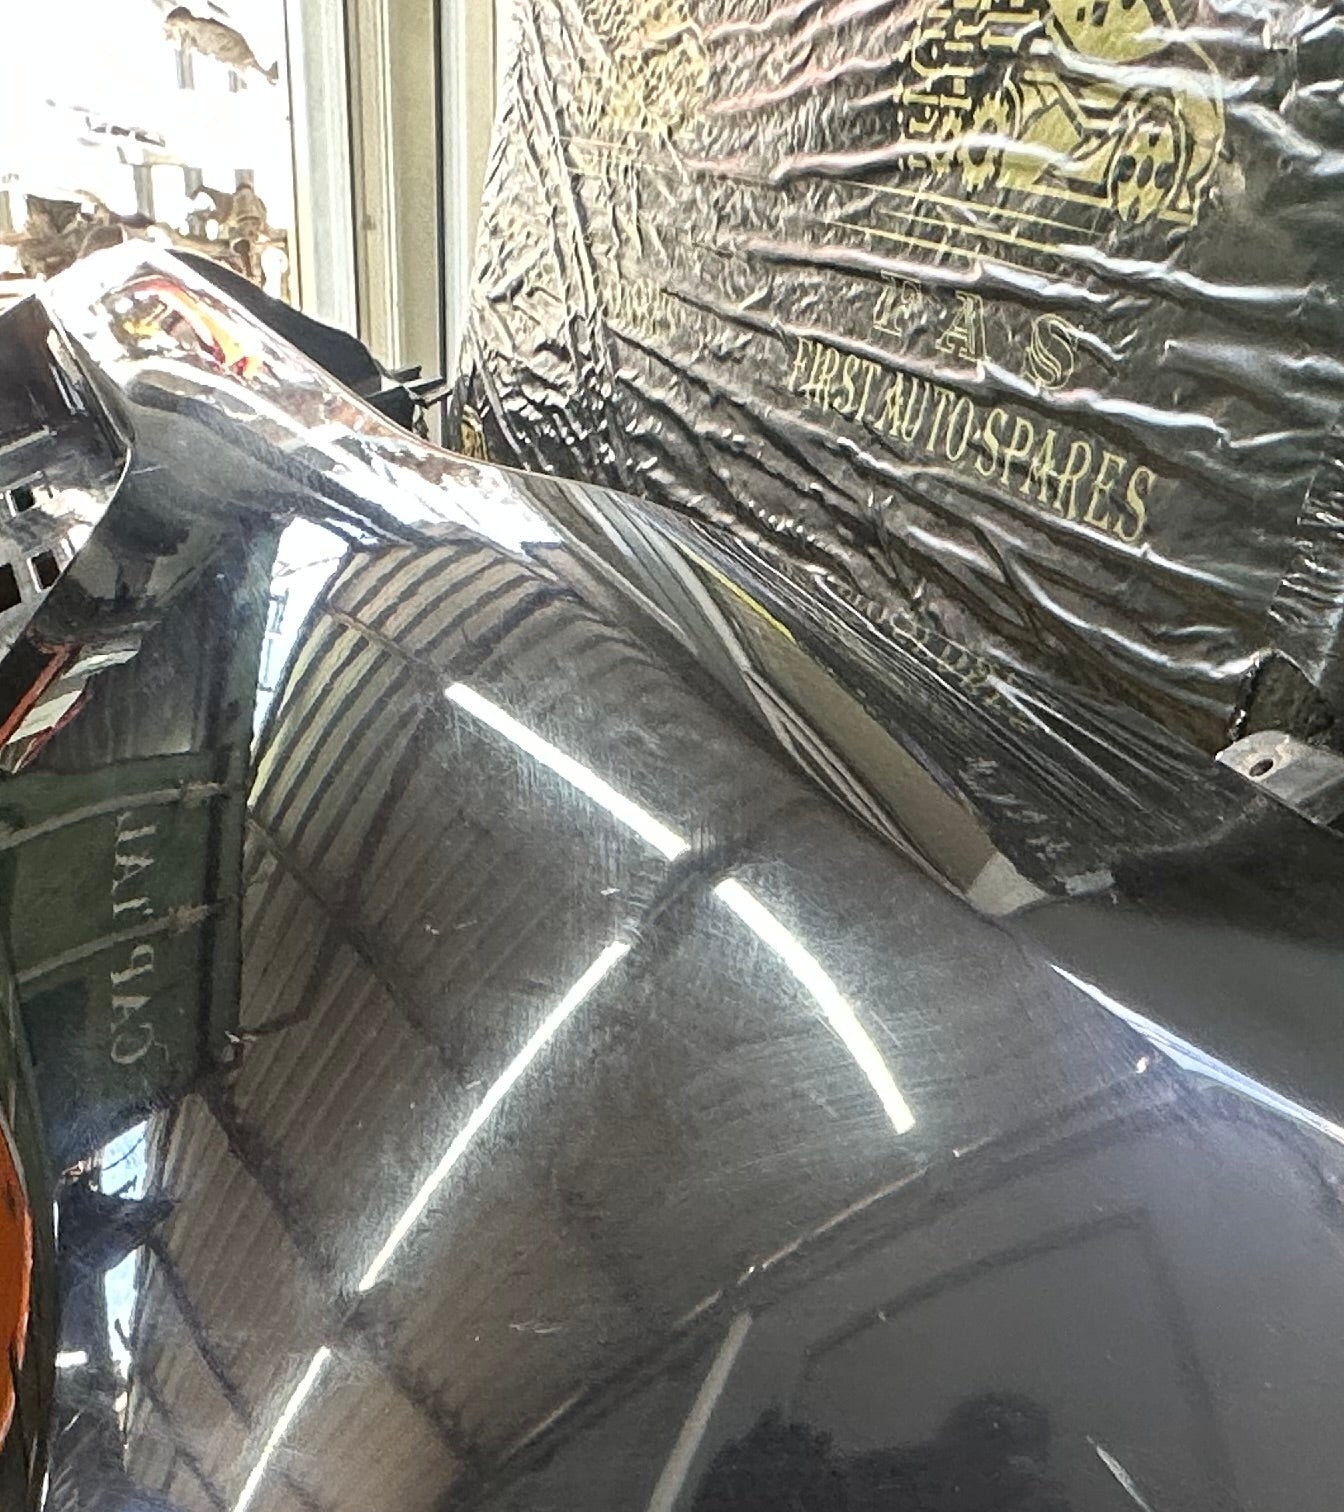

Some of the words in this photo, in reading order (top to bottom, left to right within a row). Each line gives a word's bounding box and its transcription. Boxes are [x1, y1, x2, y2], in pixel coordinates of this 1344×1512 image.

[787, 336, 881, 423] FIRST
[874, 372, 975, 462] AUTO
[975, 408, 1158, 542] SPARES
